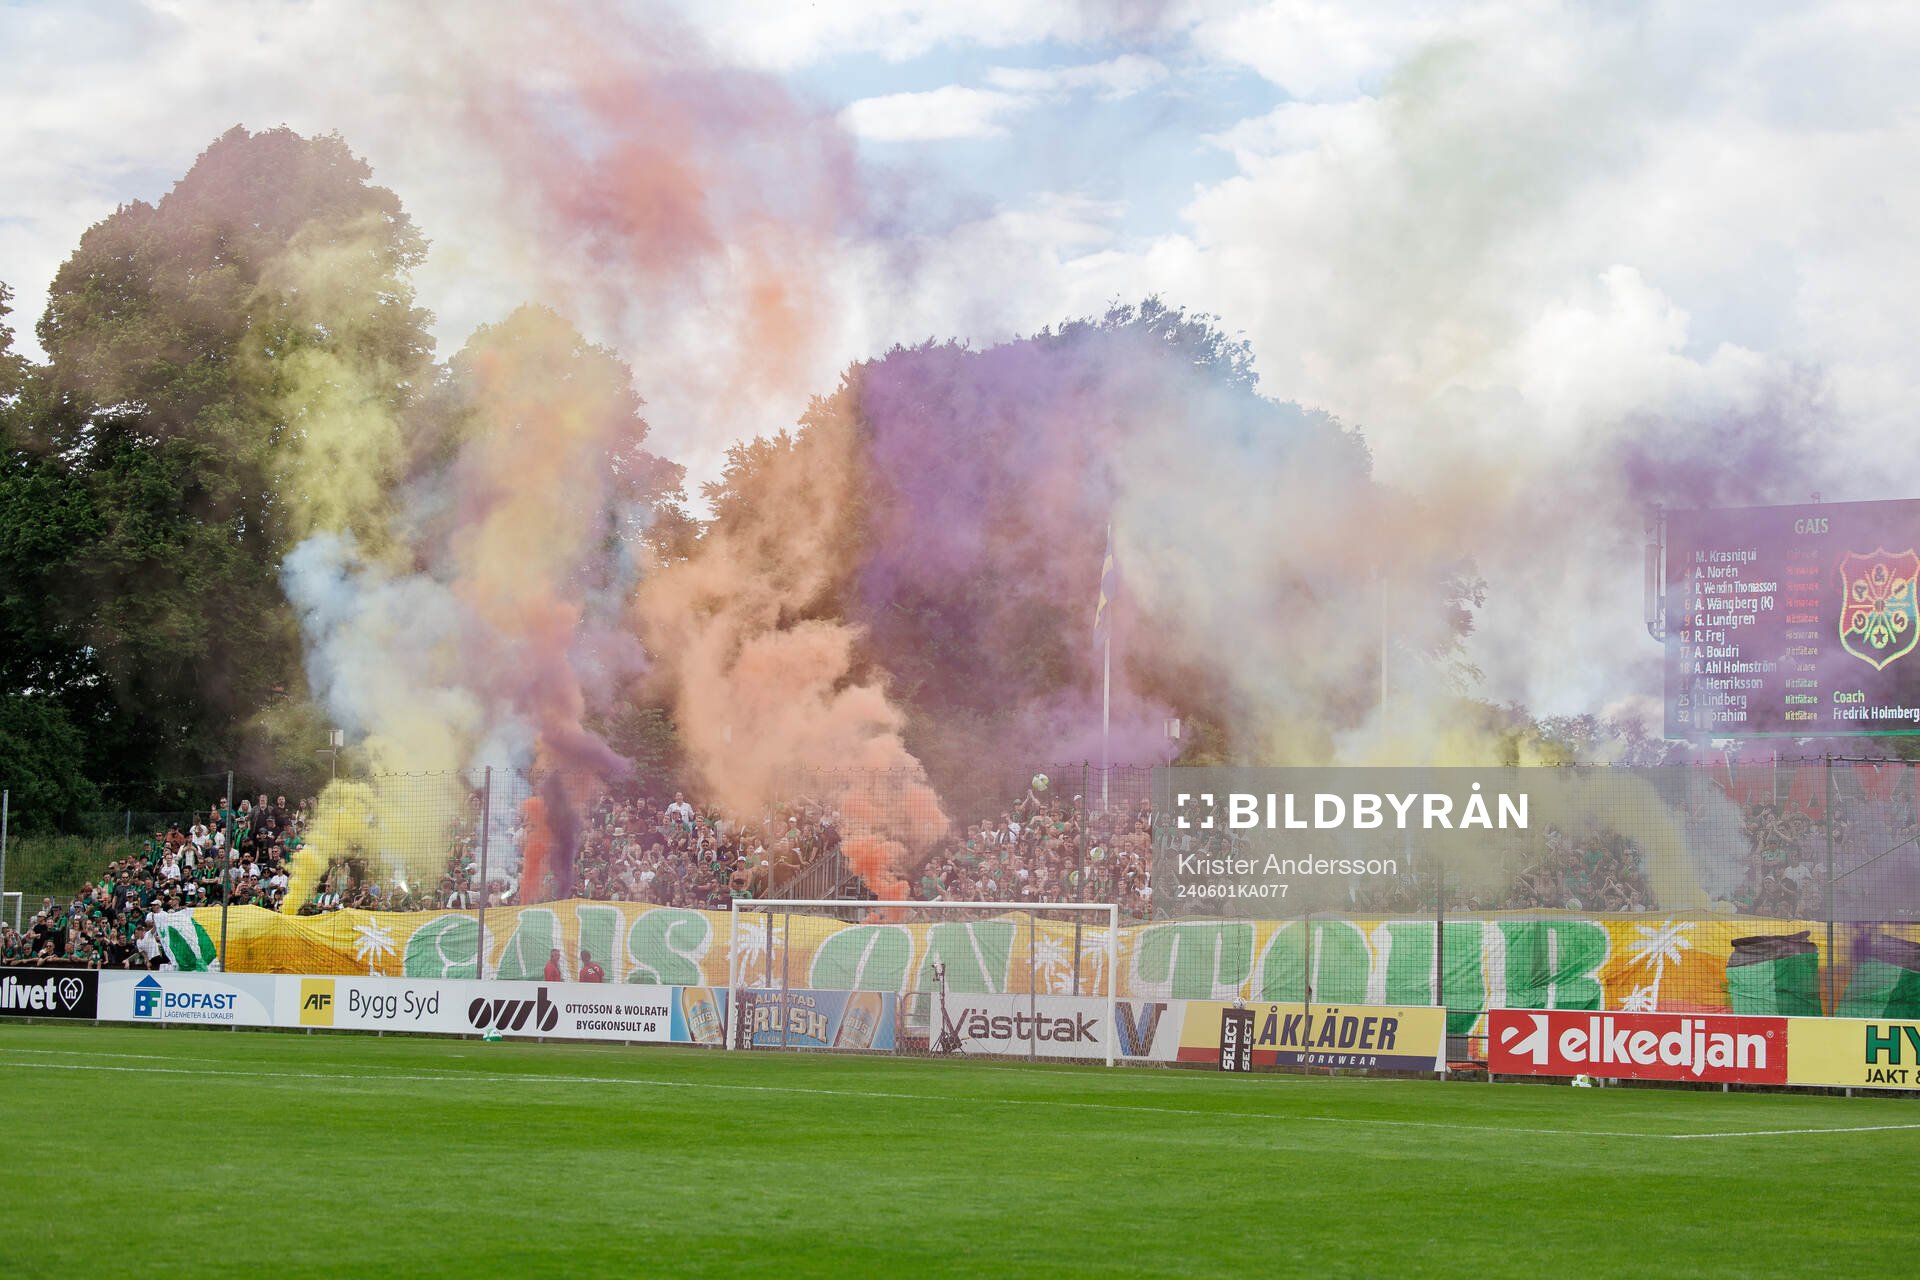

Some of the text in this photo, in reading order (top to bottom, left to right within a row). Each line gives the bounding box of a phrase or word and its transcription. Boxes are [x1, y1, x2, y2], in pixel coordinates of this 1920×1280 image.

[1794, 518, 1829, 534] GAIS
[1695, 566, 1705, 578] A.
[1707, 564, 1738, 578] Norén
[1694, 598, 1705, 611] A.
[1694, 613, 1705, 627] G.
[1706, 611, 1756, 629] Lundgren
[1694, 630, 1704, 643] R.
[1706, 628, 1725, 645] Frej
[1694, 646, 1705, 658] A.
[1706, 643, 1739, 658] Boudri
[1694, 662, 1704, 674] A.
[1705, 660, 1722, 674] Ahl
[1723, 660, 1777, 674] Holmström
[1706, 676, 1763, 690] Henriksson
[1702, 692, 1747, 709] Lindberg
[1833, 689, 1865, 703] Coach
[1833, 705, 1920, 722] Fredrik Holmberg
[0, 975, 57, 1010] livet
[164, 992, 237, 1010] BOFAST
[303, 993, 331, 1011] AF
[349, 989, 439, 1020] Bygg Syd
[565, 1003, 669, 1017] OTTOSSON & WOLRATH
[164, 1011, 201, 1020] LÄGENHETER
[207, 1012, 234, 1020] LOKALER
[576, 1020, 656, 1033] BYGGKONSULT AB
[743, 1002, 753, 1049] SELECT
[753, 1006, 829, 1044] RUSH
[942, 1008, 1099, 1045] Västtak
[1252, 1005, 1399, 1050] ÅKLÄDER
[1222, 1017, 1238, 1070] SELECT
[1242, 1018, 1253, 1071] SELECT
[1558, 1016, 1767, 1076] elkedjan
[1296, 1053, 1378, 1066] WORKWEAR
[1865, 1068, 1909, 1084] JAKT
